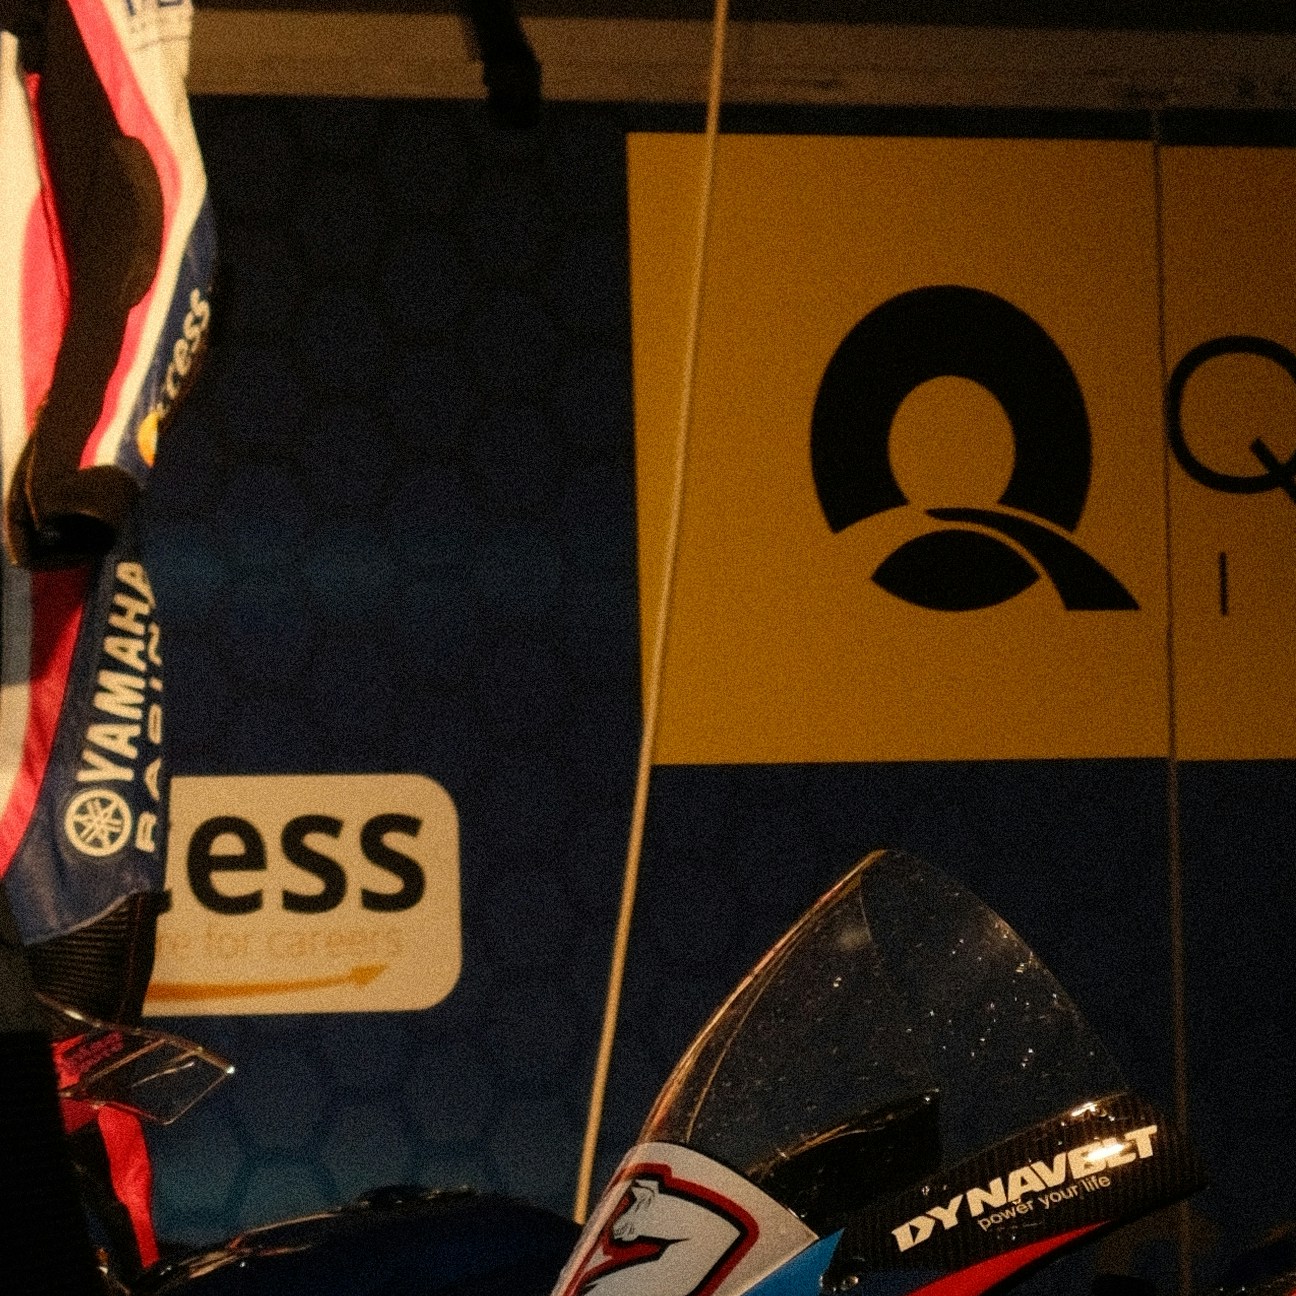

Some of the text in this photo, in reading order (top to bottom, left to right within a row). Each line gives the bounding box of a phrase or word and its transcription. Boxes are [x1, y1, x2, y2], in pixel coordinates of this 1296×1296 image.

[76, 560, 156, 783] YAMAHA
[163, 812, 427, 916] ess
[266, 927, 404, 956] careers
[976, 1174, 1113, 1233] power your life
